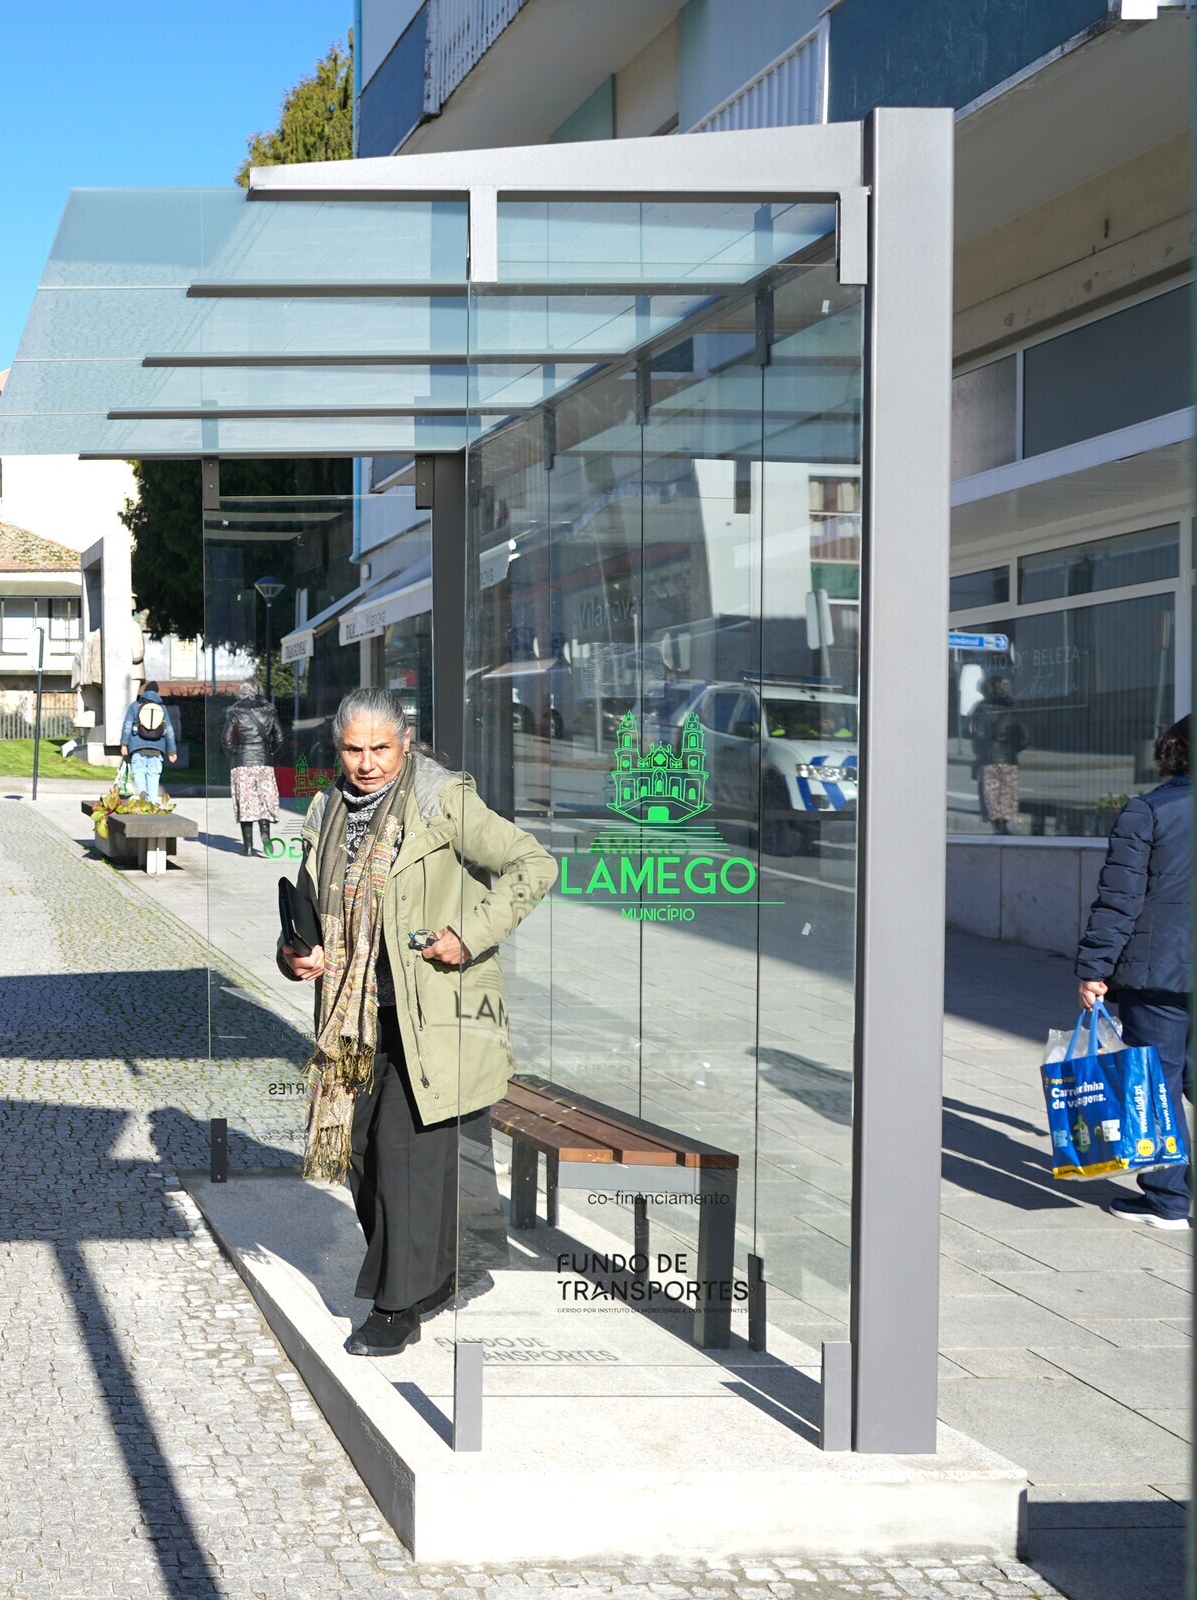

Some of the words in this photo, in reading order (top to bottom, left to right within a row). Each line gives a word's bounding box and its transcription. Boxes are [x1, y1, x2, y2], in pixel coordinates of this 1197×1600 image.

[561, 857, 756, 894] LAMEGO
[621, 905, 695, 922] MUNICÍPIO
[1052, 1098, 1066, 1110] de
[1158, 1083, 1172, 1131] www.lidl.pt
[587, 1191, 730, 1206] co-financiamento
[557, 1253, 649, 1274] FUNDO
[658, 1253, 688, 1273] DE
[557, 1281, 749, 1301] TRANSPORTES
